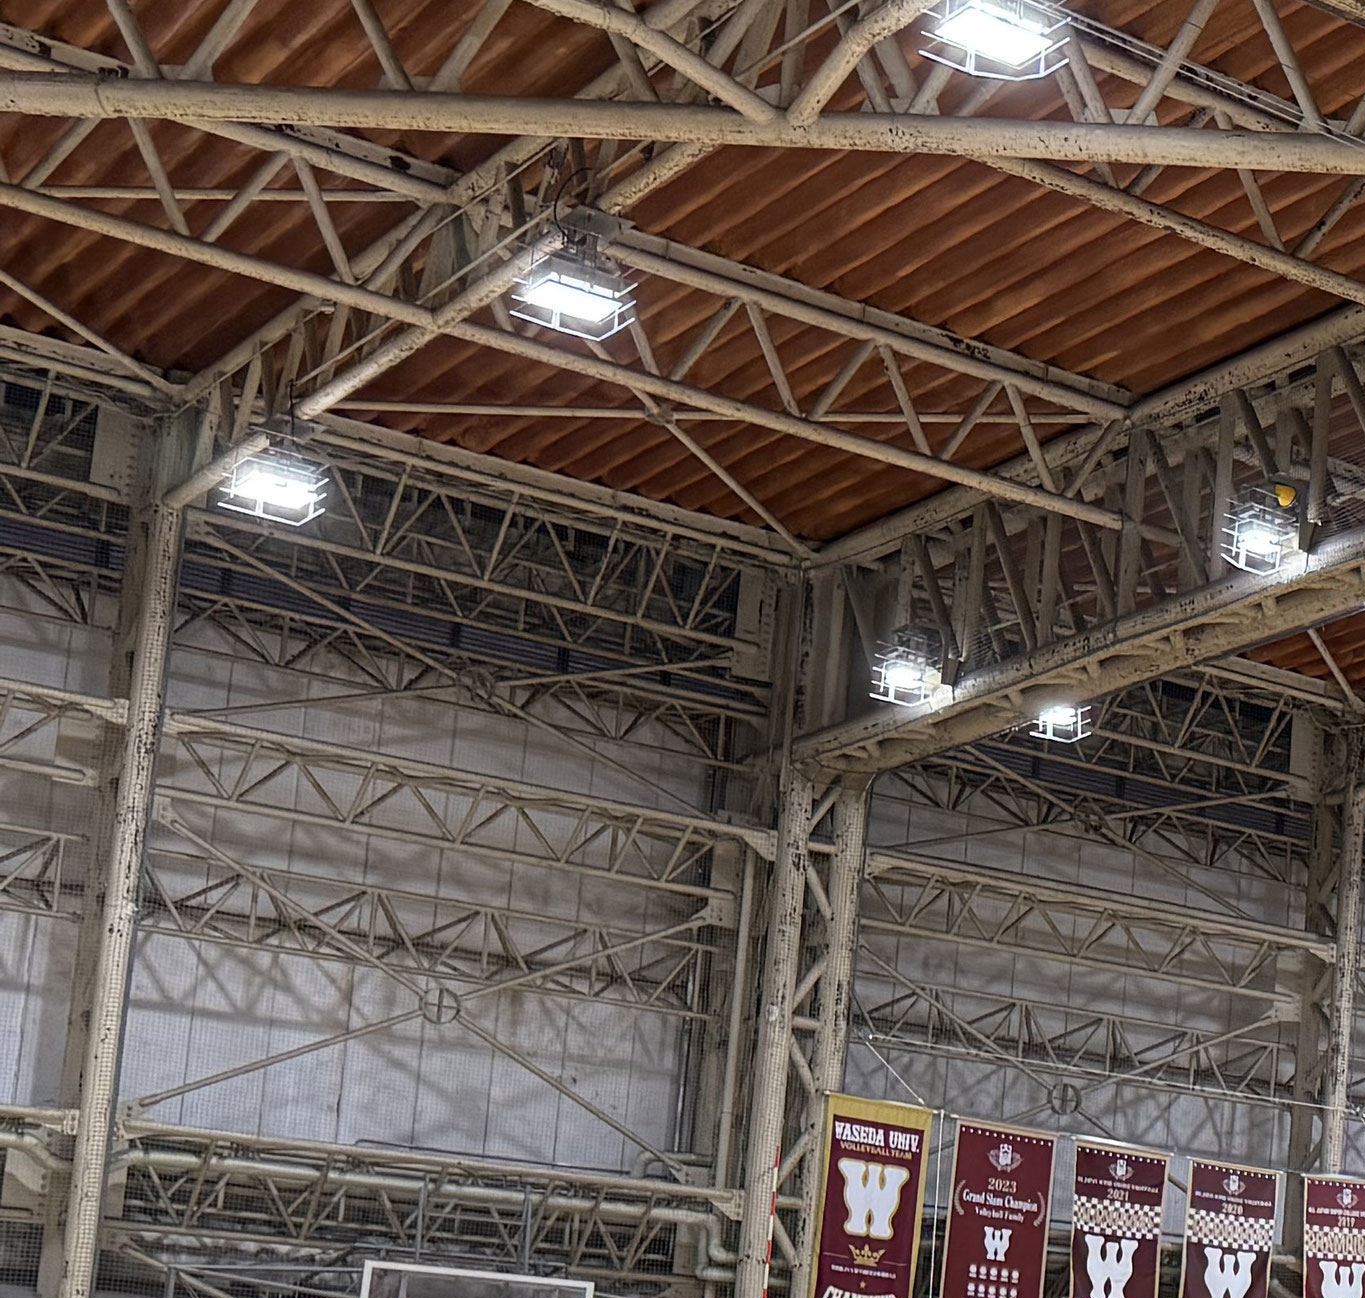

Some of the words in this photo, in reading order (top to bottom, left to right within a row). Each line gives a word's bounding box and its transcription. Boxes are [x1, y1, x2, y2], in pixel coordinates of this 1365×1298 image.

[834, 1121, 885, 1147] WASEDA
[889, 1130, 920, 1152] UNIV.
[987, 1177, 1017, 1193] 2023
[1107, 1188, 1129, 1201] 2021
[838, 1157, 910, 1240] W
[963, 1188, 985, 1204] Grand
[987, 1191, 1003, 1206] Slam
[1004, 1194, 1038, 1214] Champion
[1005, 1209, 1024, 1223] Family
[984, 1226, 1012, 1262] W
